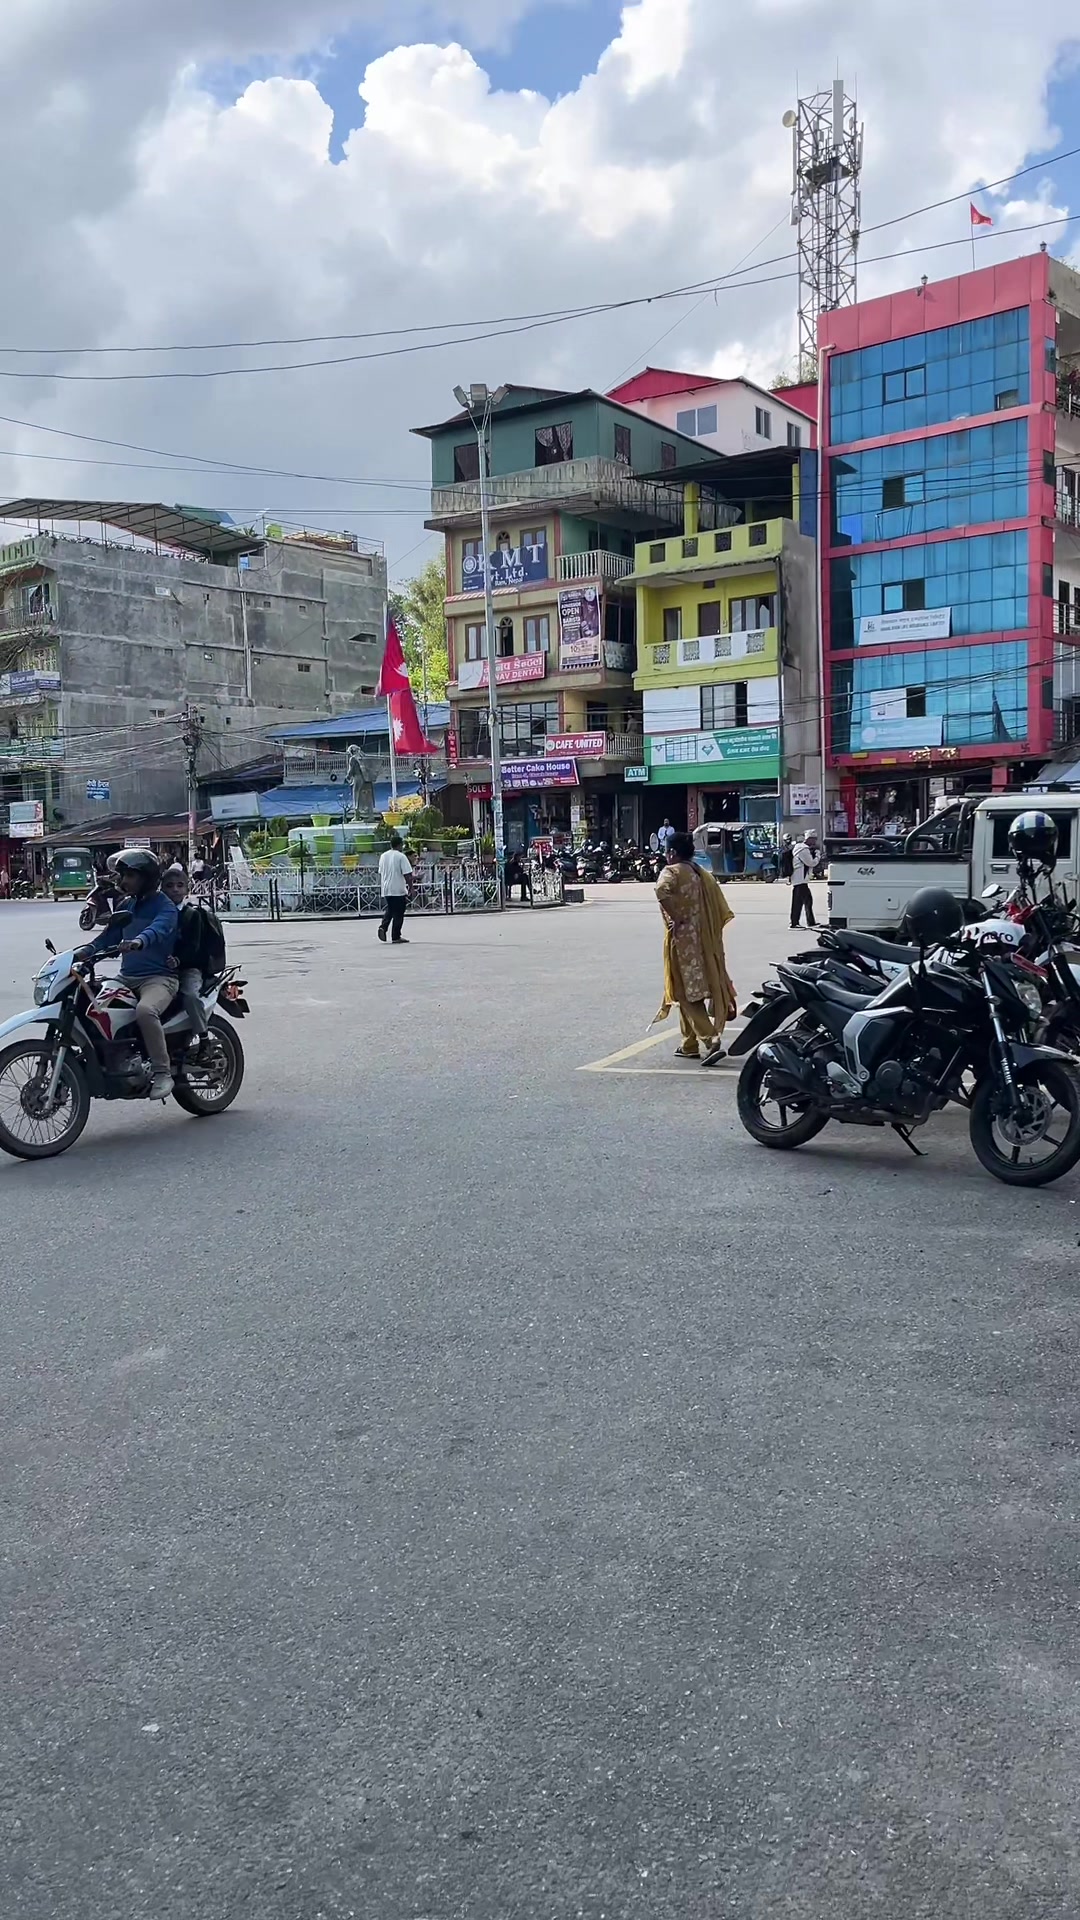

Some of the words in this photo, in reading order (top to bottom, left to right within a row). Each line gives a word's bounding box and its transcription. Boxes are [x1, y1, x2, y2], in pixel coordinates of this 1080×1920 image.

[505, 566, 528, 580] Ltd.
[561, 607, 580, 616] OPEN
[512, 667, 543, 678] DENTAL
[555, 739, 574, 750] CAFE
[575, 738, 603, 749] UNITED
[501, 765, 526, 774] Better
[525, 764, 545, 772] Cake
[545, 762, 571, 771] House
[627, 767, 646, 778] ATM
[467, 784, 487, 793] SOLE
